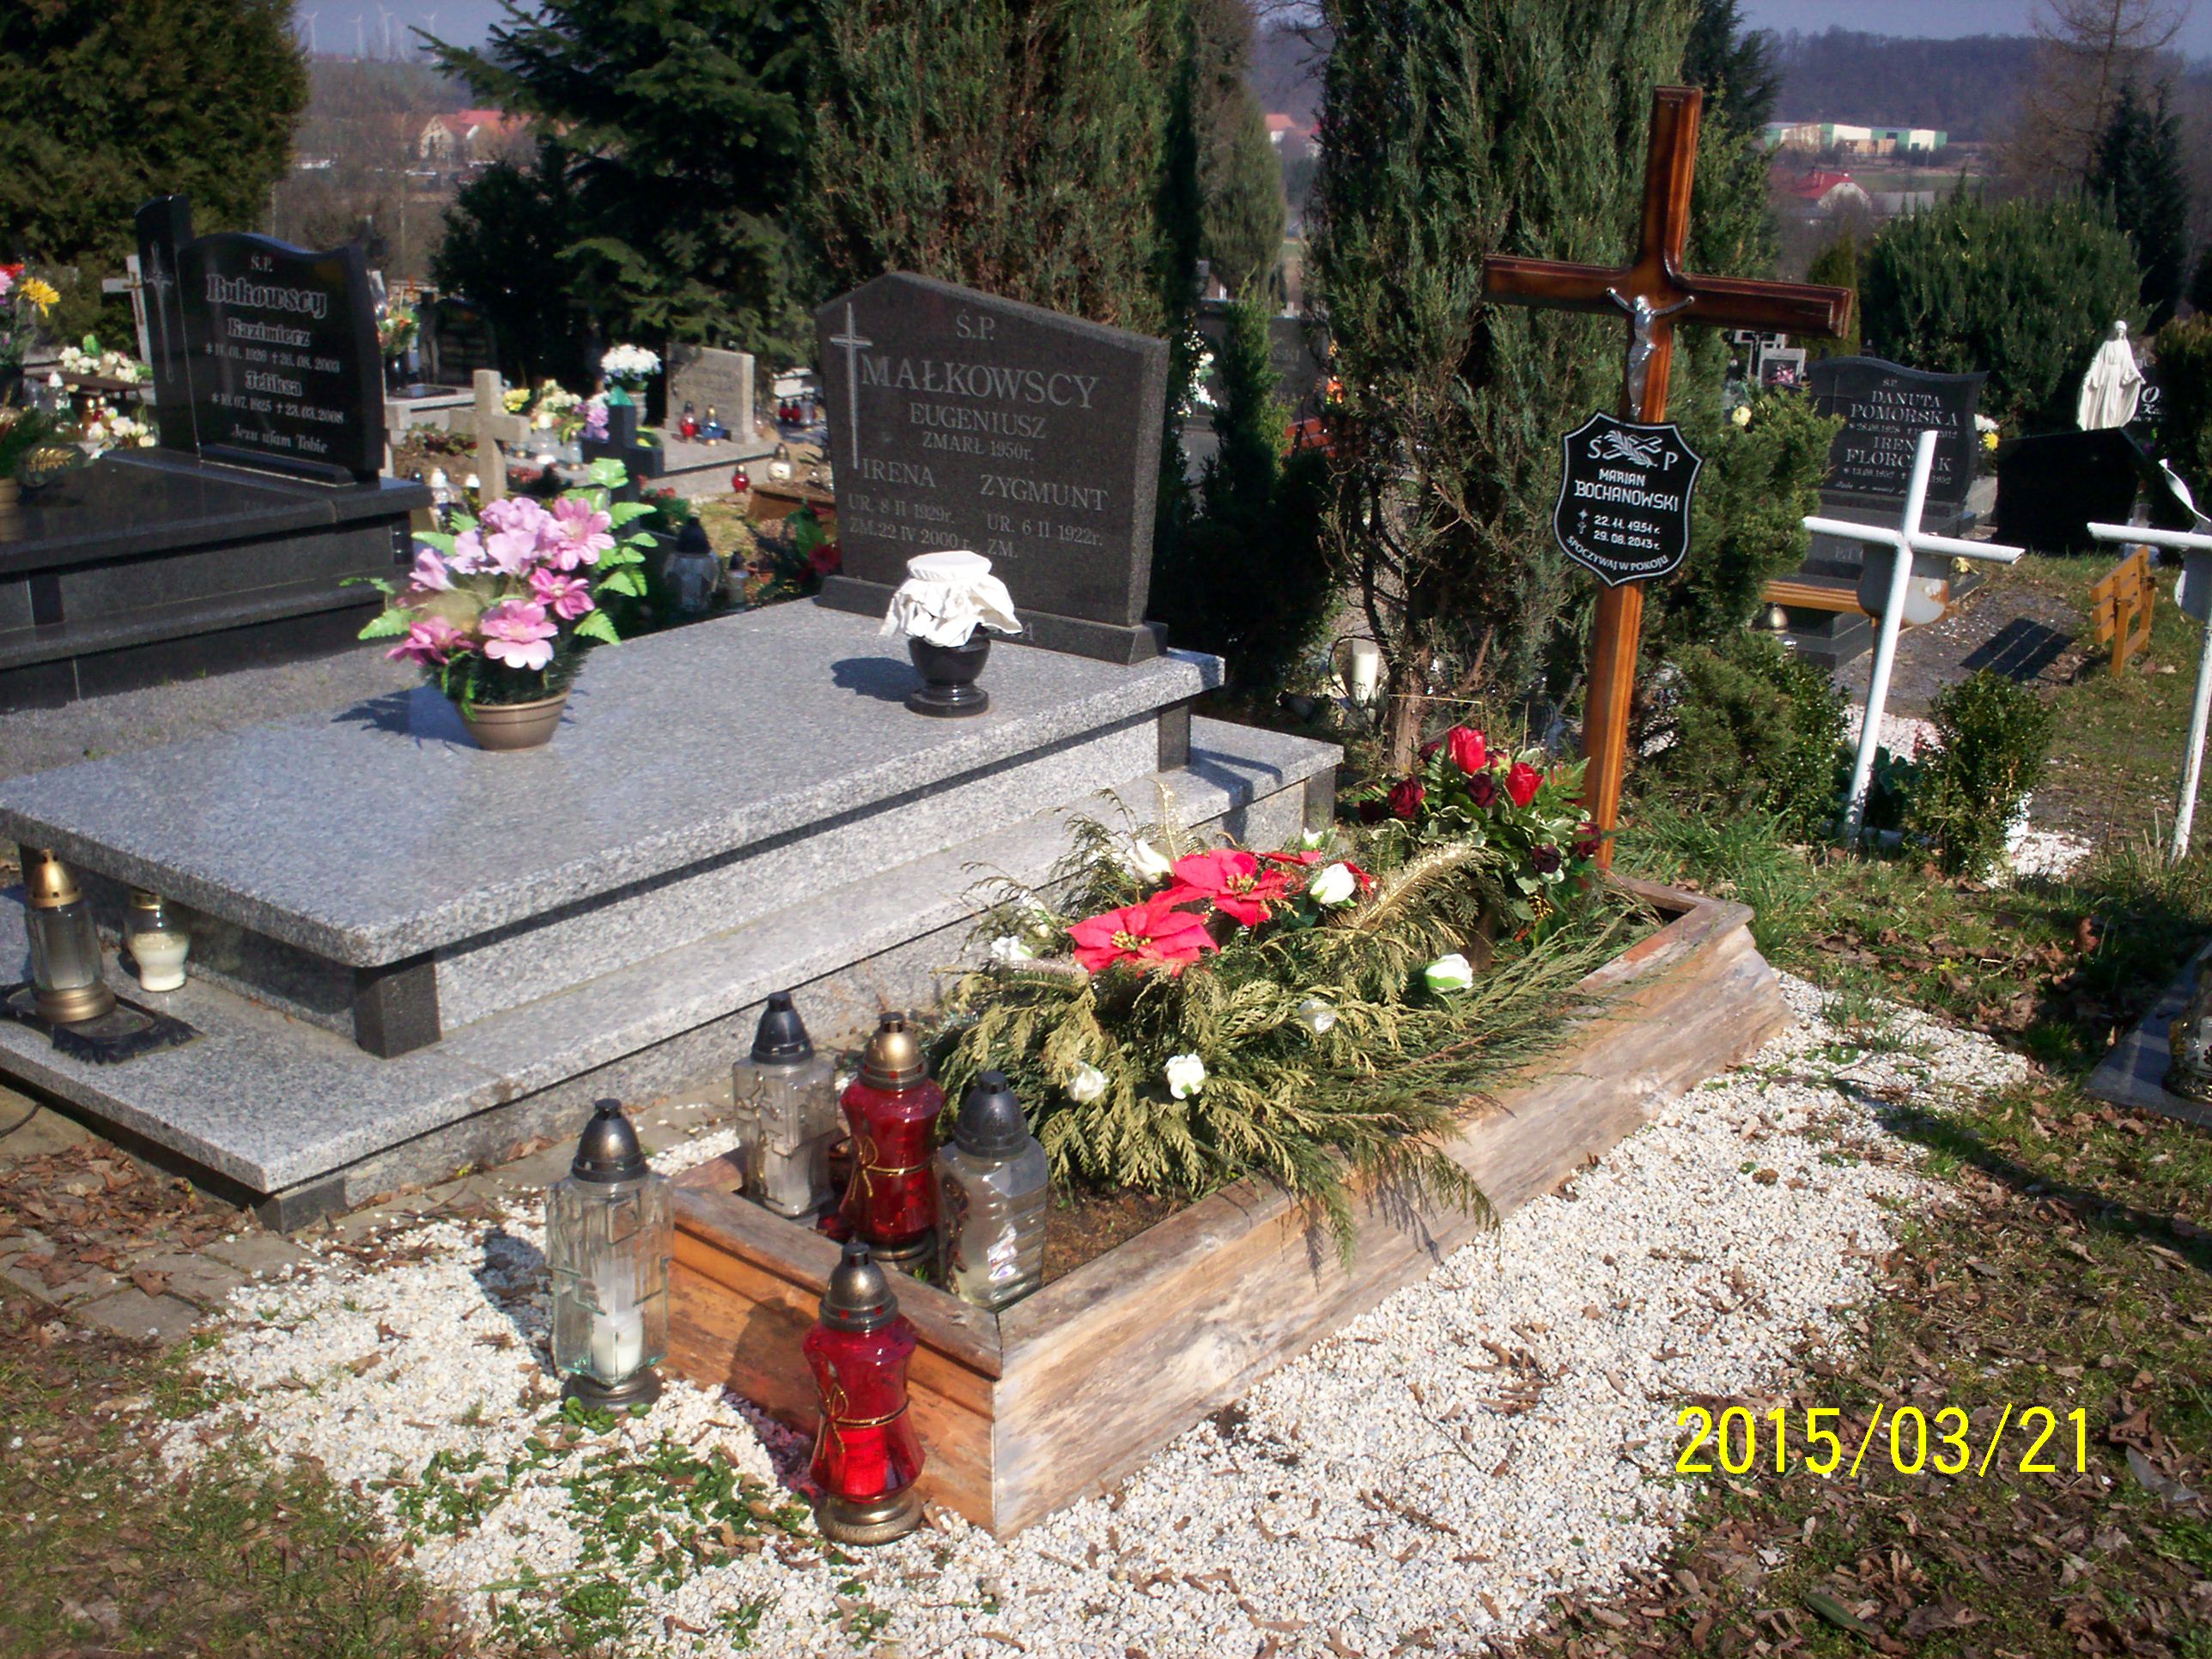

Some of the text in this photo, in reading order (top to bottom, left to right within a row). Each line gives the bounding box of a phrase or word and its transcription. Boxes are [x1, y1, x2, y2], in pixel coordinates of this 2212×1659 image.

[206, 274, 328, 319] Bukowscy
[228, 317, 311, 347] Kazimierz
[861, 354, 1100, 409] MAŁKOWSCY
[1872, 391, 1941, 408] DANUTA
[910, 402, 1047, 439] EUGENIUSZ
[1850, 404, 1958, 427] POMORSKA
[922, 431, 985, 455] ZMARŁ
[1874, 436, 1916, 451] IREN
[1662, 452, 1678, 471] P
[1845, 448, 1952, 471] FLORCK
[862, 458, 936, 488] IRENA
[1599, 468, 1646, 487] MARIAN
[980, 474, 1109, 512] ZYGMUNT
[1573, 479, 1679, 512] BOCHANOWSKI
[880, 498, 890, 514] 8
[988, 514, 1015, 533] UR.
[1022, 520, 1031, 536] 6
[921, 529, 958, 548] 2000
[1566, 535, 1669, 571] SPOCZYWAJ W POKOJU
